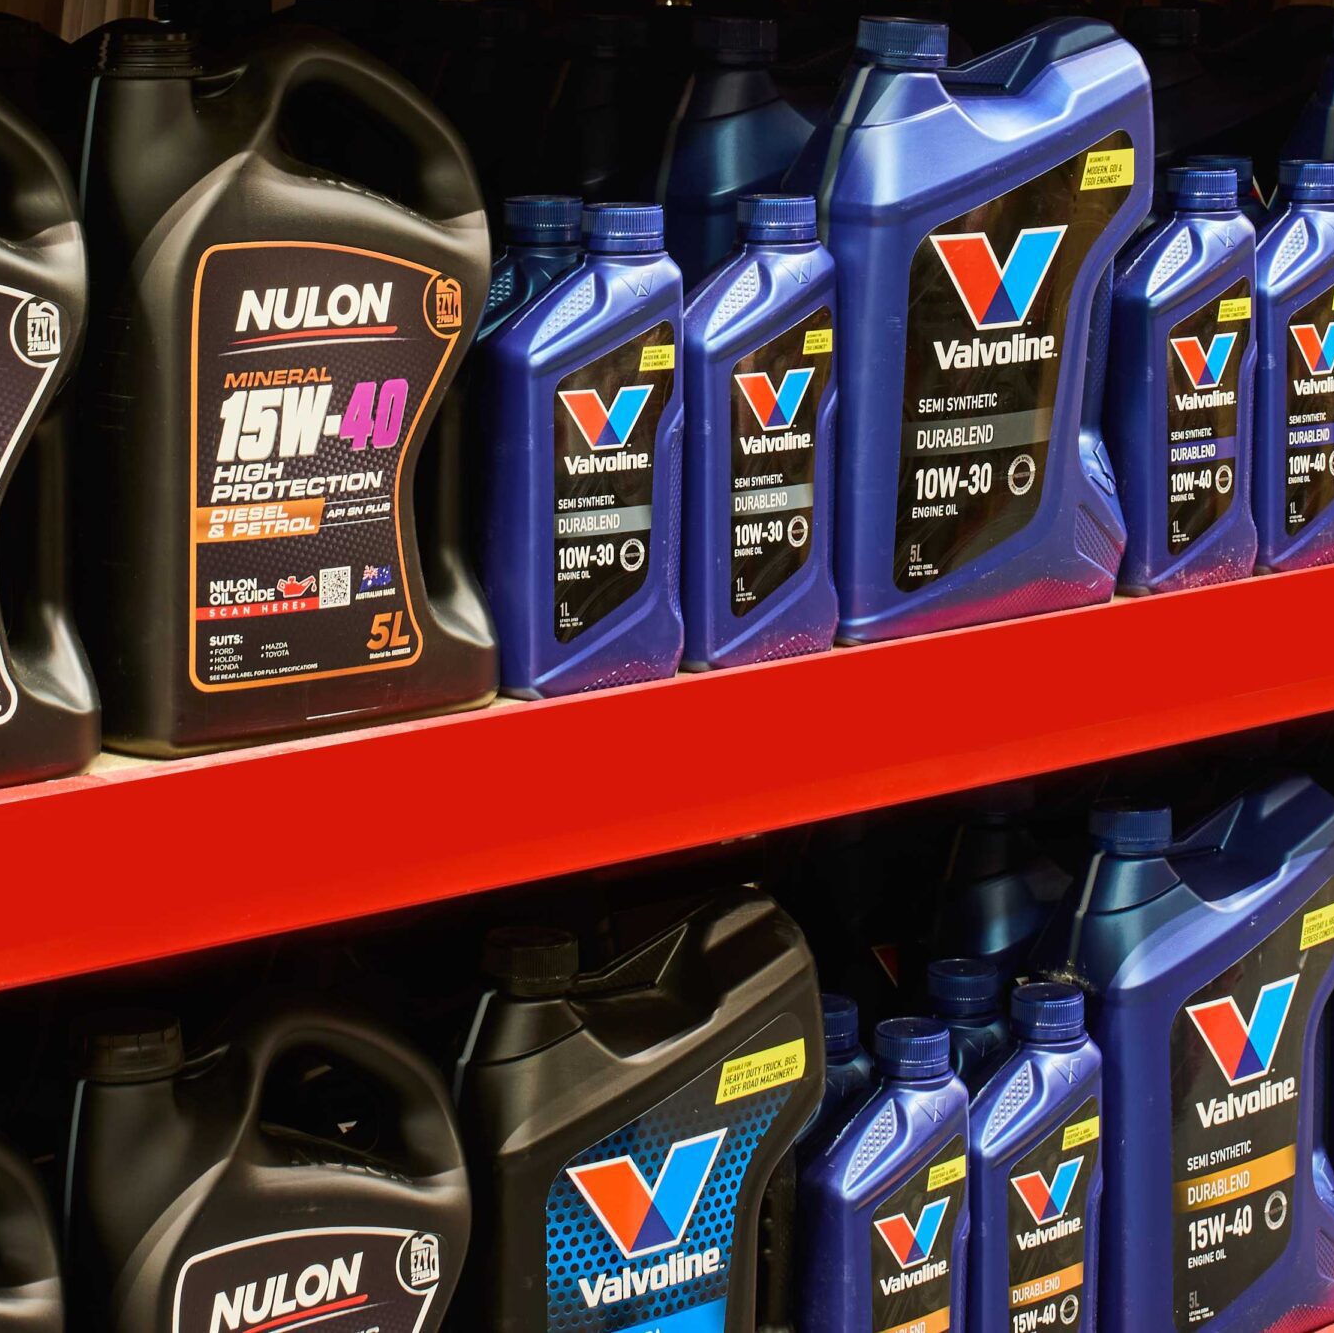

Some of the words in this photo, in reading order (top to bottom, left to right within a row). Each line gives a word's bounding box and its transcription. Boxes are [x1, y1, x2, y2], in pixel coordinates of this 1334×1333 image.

[235, 282, 393, 332] NULON
[933, 333, 1057, 371] Valvoline
[224, 367, 332, 389] MINERAL
[215, 377, 409, 462] 15W-40
[918, 396, 944, 413] SEMI
[946, 392, 998, 411] SYNTHETIC
[915, 423, 994, 450] DURABLEND
[564, 450, 651, 476] Valvoline
[210, 471, 383, 503] PROTECTION
[914, 462, 992, 501] 10W-30
[558, 545, 615, 570] 10W-30
[366, 610, 410, 650] 5L
[724, 1071, 745, 1085] HEAVY
[746, 1066, 762, 1079] DUTY
[1195, 1075, 1298, 1129] Valvoline
[1187, 1170, 1251, 1205] DURABLEND
[1016, 1216, 1083, 1251] Valvoline
[1187, 1205, 1253, 1250] 15W-40
[209, 1251, 364, 1332] NULON
[578, 1246, 726, 1309] Valvoline
[1012, 1303, 1057, 1333] 15W-40
